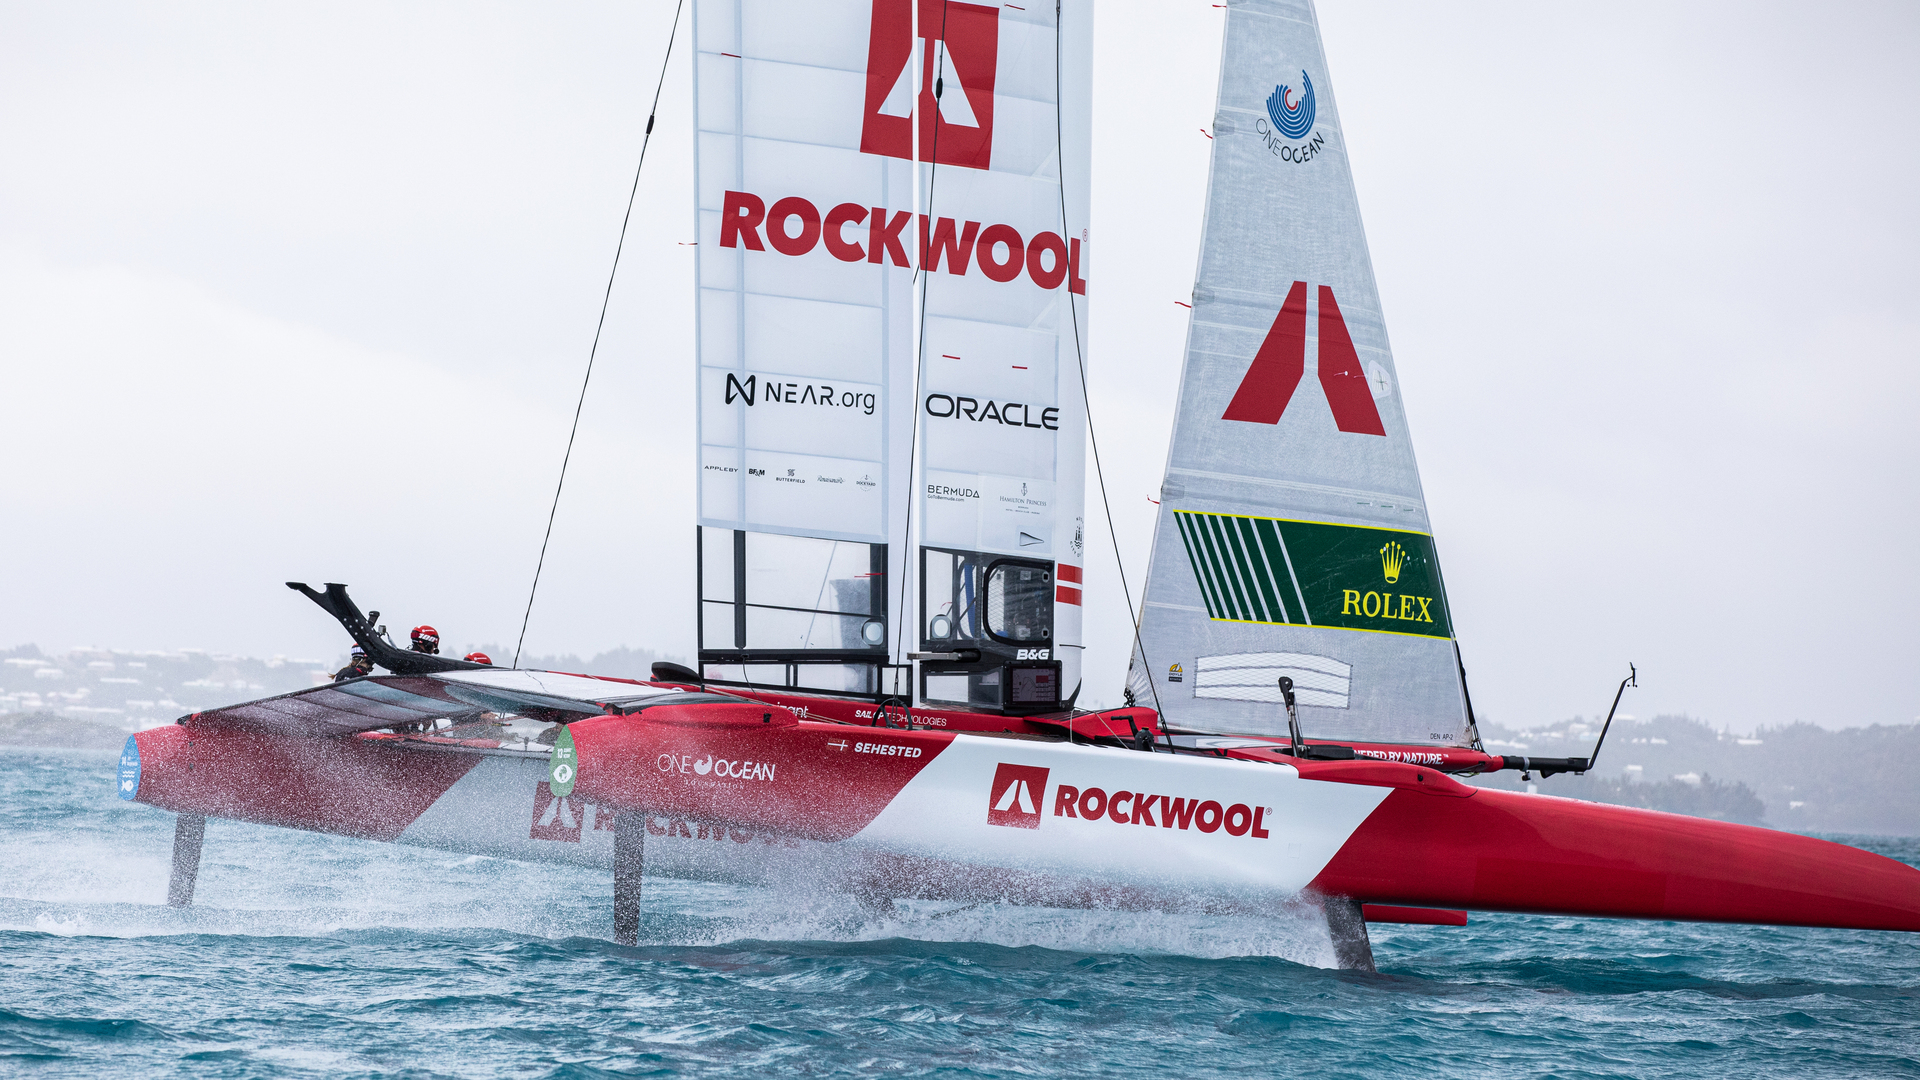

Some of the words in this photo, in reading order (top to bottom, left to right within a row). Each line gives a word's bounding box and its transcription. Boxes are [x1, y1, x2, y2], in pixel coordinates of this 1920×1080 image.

[765, 381, 876, 415] NEAR.org
[925, 393, 1060, 431] ORACLE
[704, 465, 739, 473] APPLEBY
[927, 484, 980, 498] BERMUDA
[999, 495, 1025, 504] HAMILTON
[1026, 498, 1047, 507] PRINCESS
[1341, 589, 1434, 623] ROLEX
[1016, 648, 1050, 660] B&G
[854, 709, 884, 720] SAILP
[886, 712, 948, 727] TECHOLOGIES
[1429, 732, 1441, 740] DEN
[854, 742, 922, 758] SEHESTED
[657, 753, 692, 776] ONE
[714, 759, 776, 782] OCEAN
